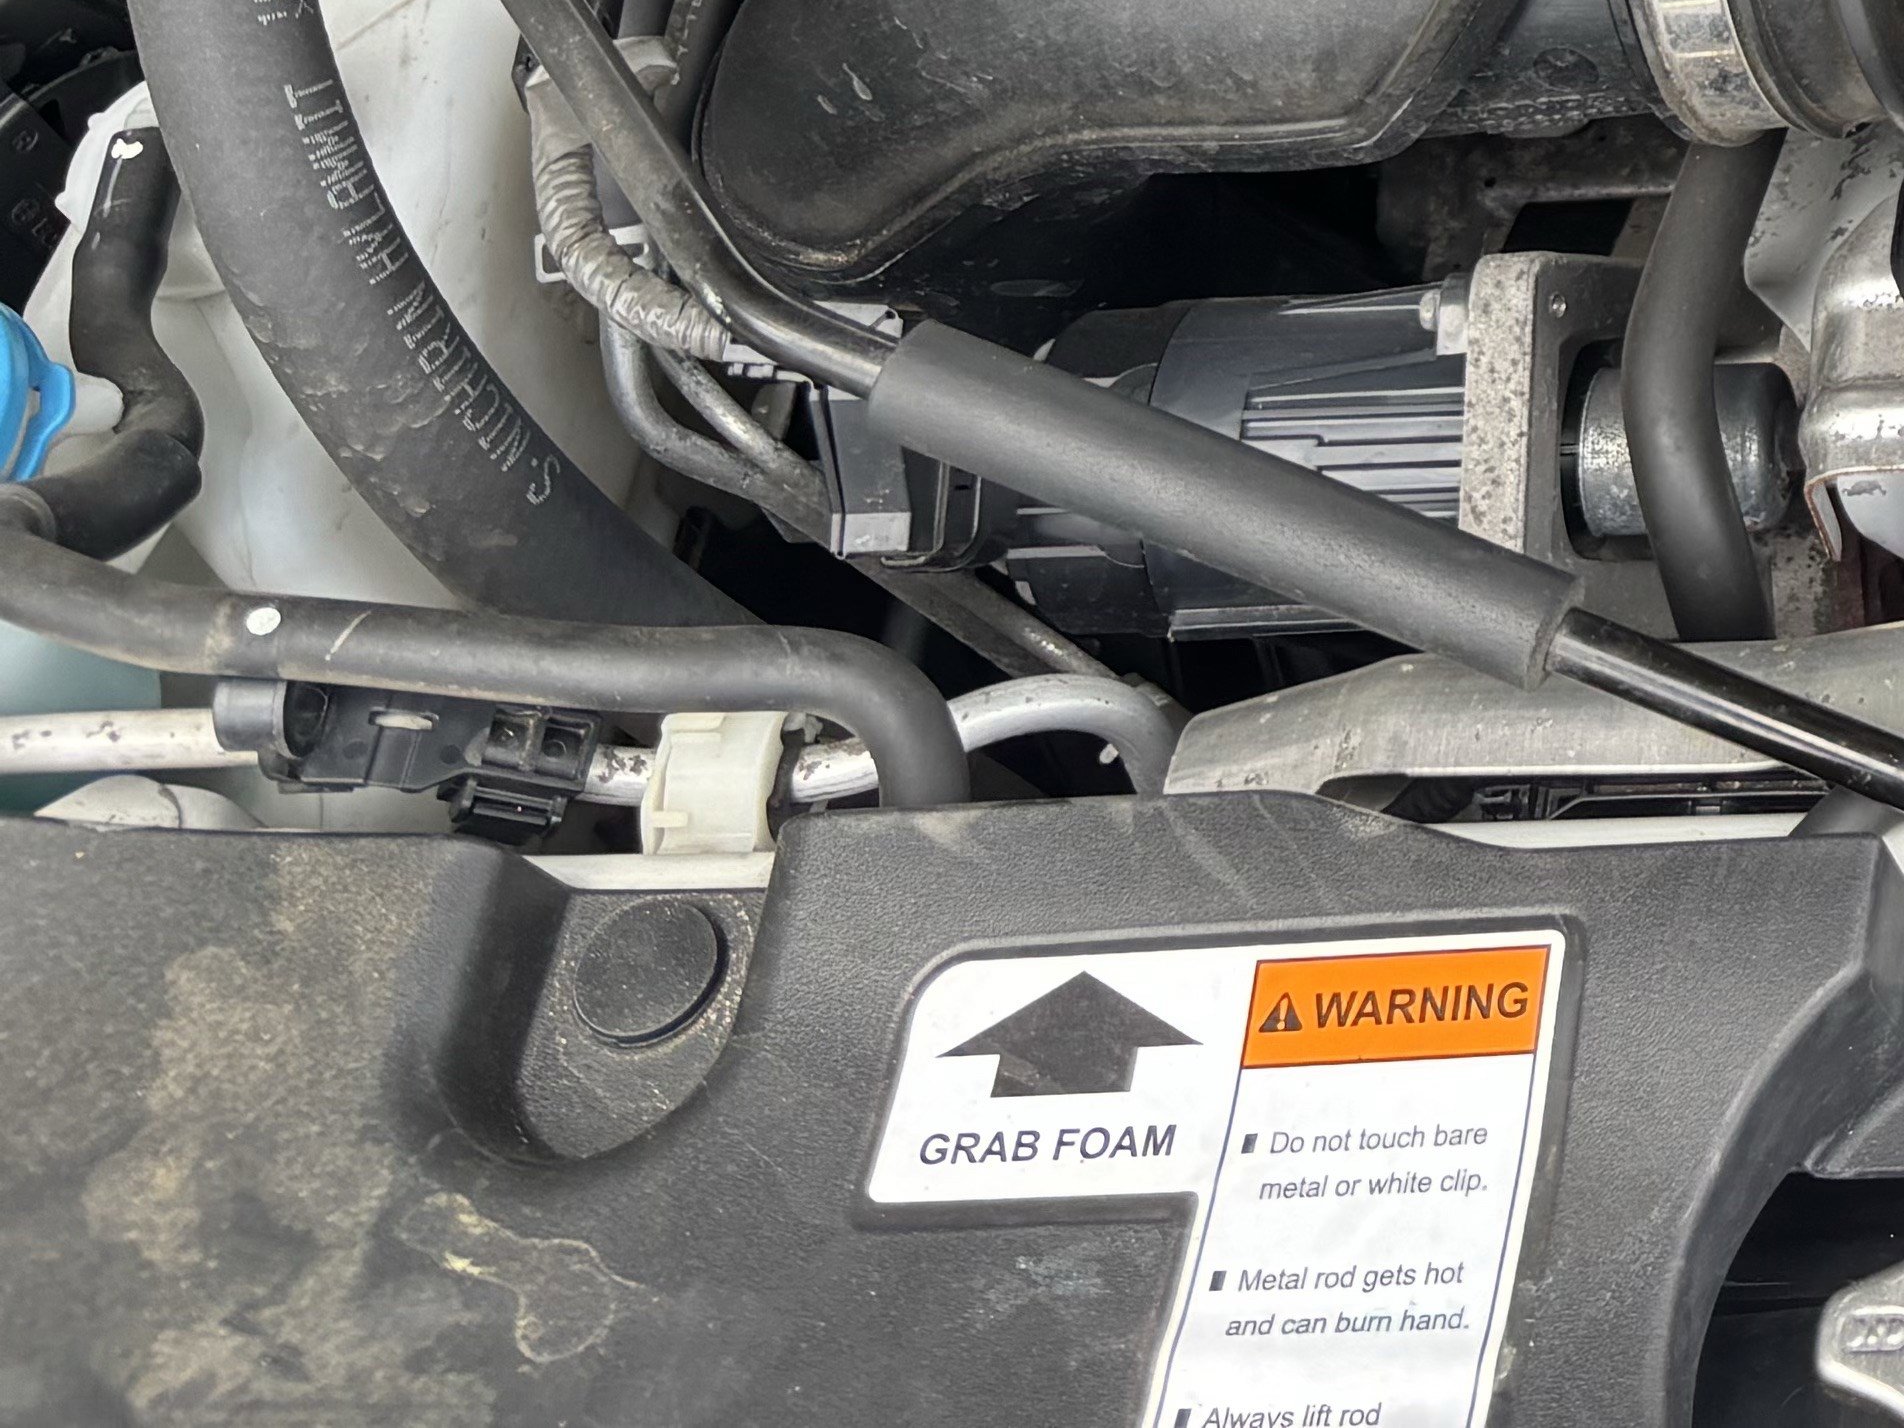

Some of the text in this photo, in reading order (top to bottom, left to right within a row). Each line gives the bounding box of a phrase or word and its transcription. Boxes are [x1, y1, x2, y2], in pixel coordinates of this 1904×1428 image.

[1314, 982, 1529, 1029] WARNING
[918, 1124, 1178, 1166] GRAB FOAM
[1270, 1123, 1488, 1154] Do not touch bare
[1259, 1168, 1488, 1200] metal or white clip.
[1238, 1262, 1464, 1293] Metal rod gets hot
[1225, 1306, 1471, 1337] and can burn hand.
[1202, 1401, 1382, 1428] Always lift rod
